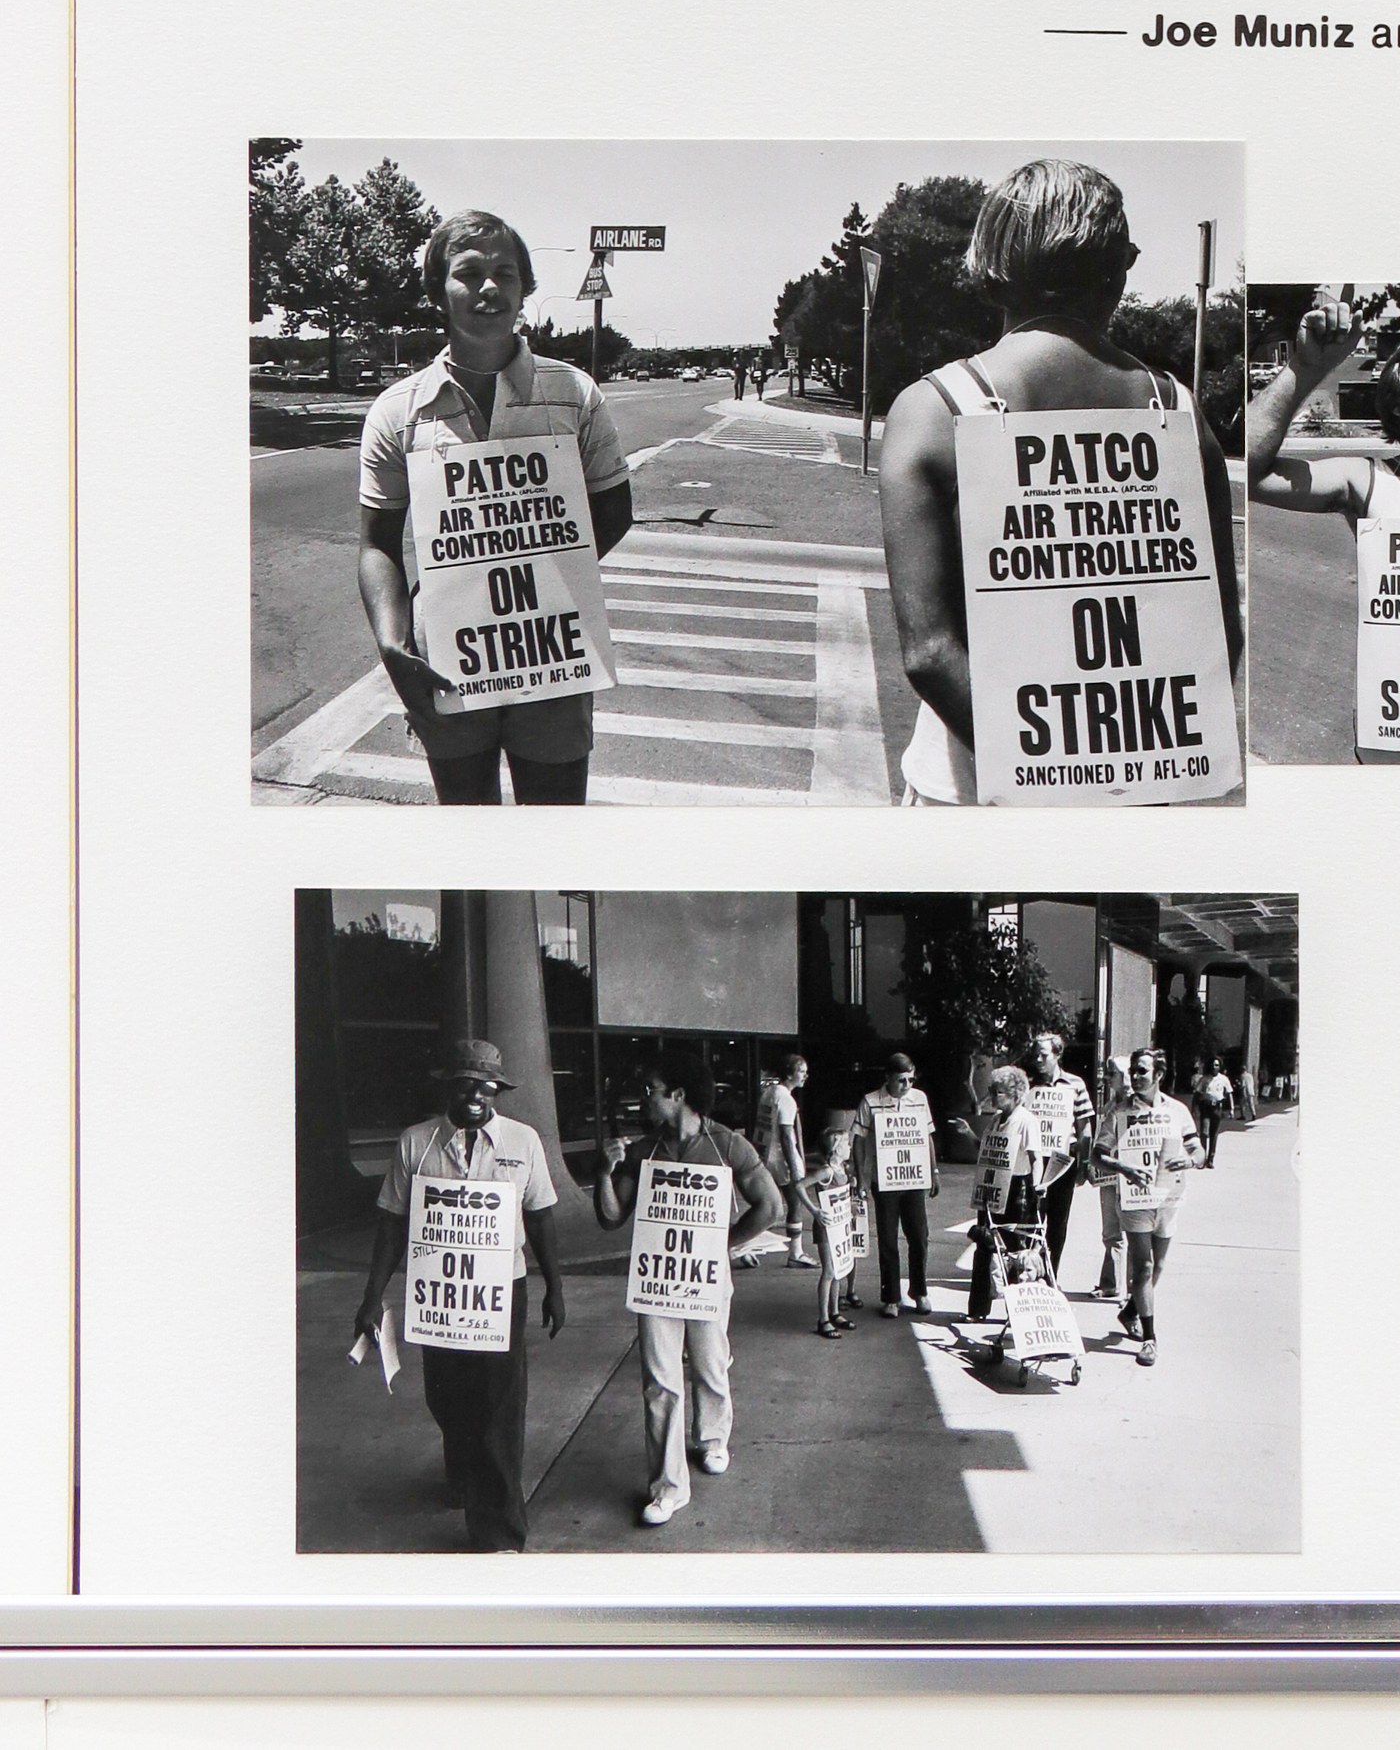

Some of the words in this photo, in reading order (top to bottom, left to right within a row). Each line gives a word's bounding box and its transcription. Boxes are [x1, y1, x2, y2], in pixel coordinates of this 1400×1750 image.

[1142, 14, 1217, 47] Joe
[1235, 15, 1354, 47] Muniz
[594, 230, 647, 248] AIRLANE
[589, 267, 602, 278] BUS
[587, 279, 603, 291] STOP
[1015, 432, 1159, 486] PATCO
[444, 452, 548, 497] PATCO
[1023, 488, 1061, 497] Affiliated
[1121, 485, 1158, 494] (AFL-CIO)
[440, 507, 474, 534] AIR
[479, 495, 566, 527] TRAFFIC
[1003, 503, 1056, 540] AIR
[1064, 498, 1181, 536] TRAFFIC
[431, 521, 579, 562] CONTROLLERS
[989, 537, 1197, 581] CONTROLLERS
[488, 563, 538, 616] ON
[1072, 595, 1142, 671] ON
[455, 611, 585, 676] STRIKE
[459, 676, 524, 697] SANCTIONED
[529, 672, 543, 686] BY
[550, 664, 591, 683] AFL-CIO
[1016, 674, 1203, 756] STRIKE
[1015, 764, 1115, 786] SANCTIONED
[1125, 762, 1143, 782] BY
[1154, 755, 1210, 780] AFL-CIO
[1035, 1090, 1064, 1101] PATCO
[886, 1117, 917, 1128] PATCO
[1040, 1120, 1053, 1133] ON
[880, 1138, 925, 1146] CONTROLLERS
[884, 1131, 894, 1139] AIR
[896, 1130, 922, 1138] TRAFFIC
[1041, 1135, 1062, 1148] RIKE
[1129, 1129, 1140, 1137] AIR
[897, 1149, 911, 1164] ON
[651, 1167, 719, 1191] patco
[886, 1164, 923, 1181] STRIKE
[424, 1185, 501, 1210] patco
[652, 1190, 668, 1204] AIR
[674, 1192, 714, 1209] TRAFFIC
[426, 1210, 443, 1226] AIR
[451, 1213, 497, 1229] TRAFFIC
[647, 1205, 717, 1224] CONTROLLERS
[422, 1226, 500, 1246] CONTROLLERS
[664, 1227, 694, 1254] ON
[412, 1245, 438, 1259] STILL
[442, 1252, 475, 1280] ON
[637, 1252, 719, 1285] STRIKE
[414, 1278, 504, 1312] STRIKE
[641, 1281, 670, 1296] LOCAL
[1018, 1286, 1055, 1297] PATCO
[419, 1309, 451, 1326] LOCAL
[1035, 1315, 1054, 1328] ON
[1024, 1330, 1072, 1346] STRIKE
